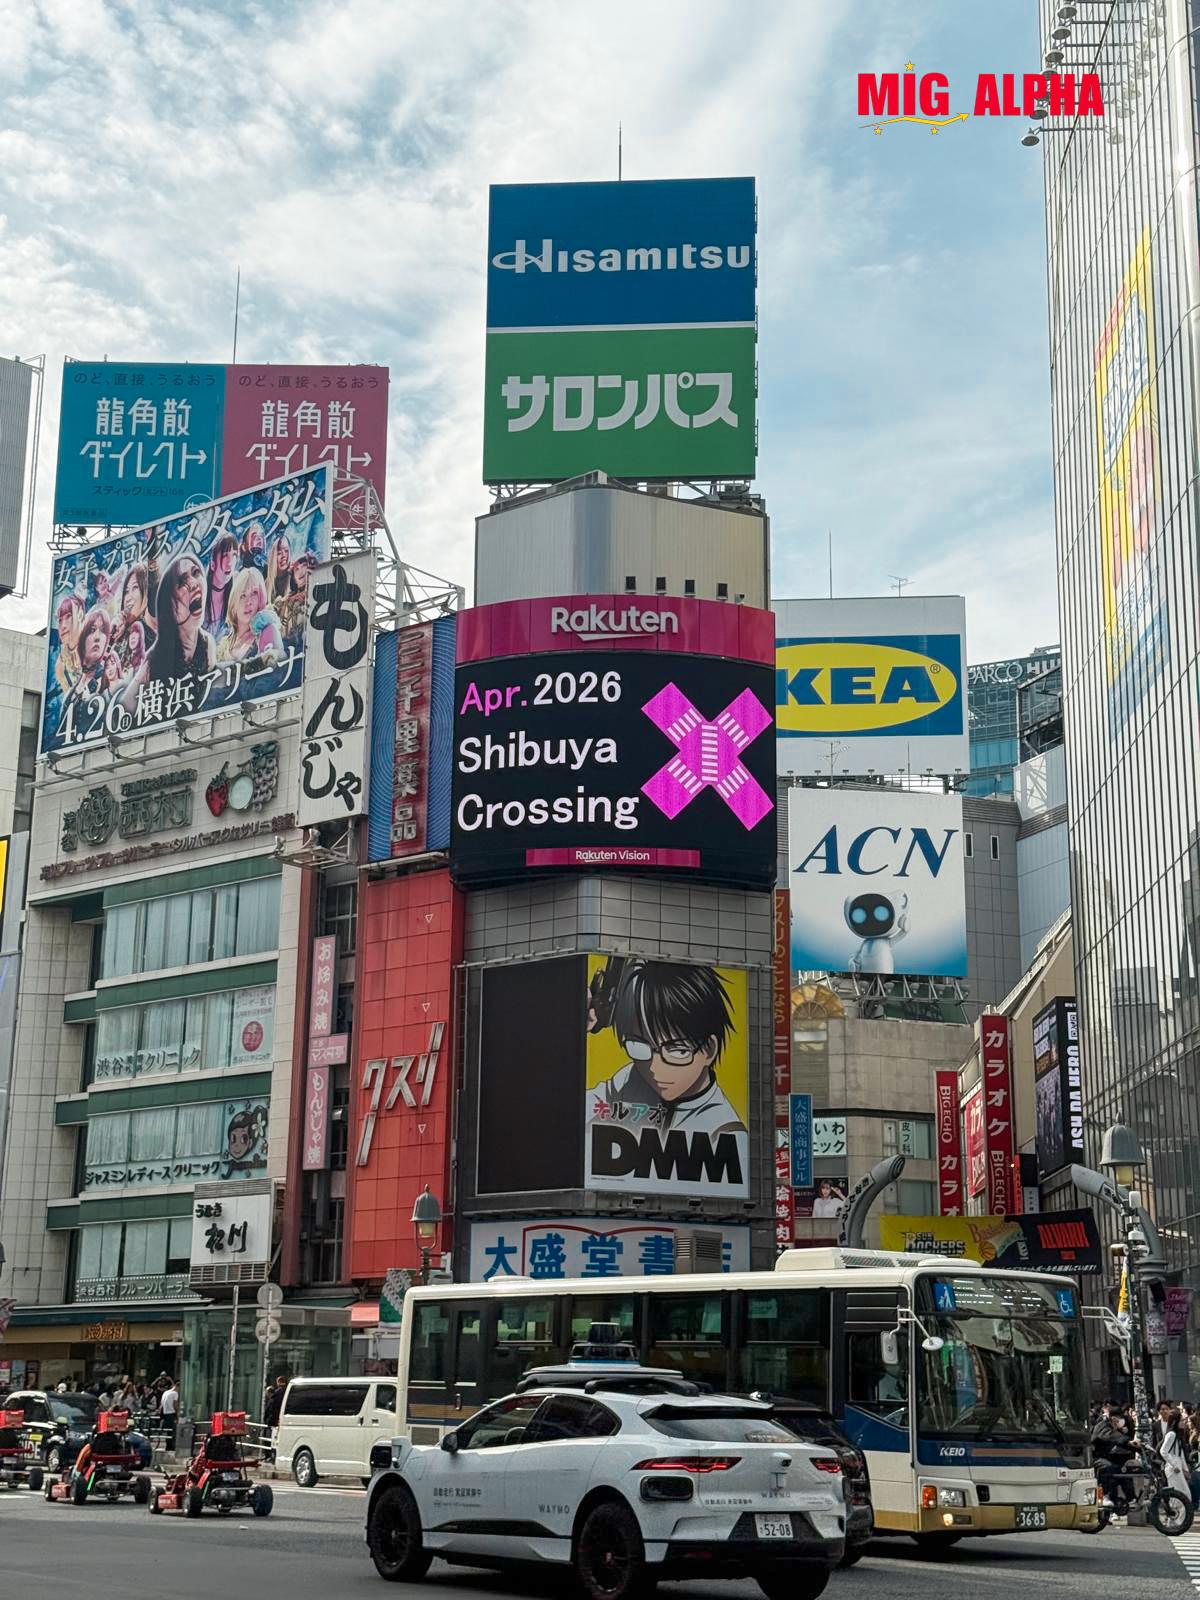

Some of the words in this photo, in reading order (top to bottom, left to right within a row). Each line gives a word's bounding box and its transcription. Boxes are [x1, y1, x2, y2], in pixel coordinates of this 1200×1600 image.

[491, 238, 750, 274] Hisamitsu
[96, 396, 192, 437] 龍角散
[261, 399, 356, 439] 龍角散
[501, 371, 738, 433] サロンパス
[79, 440, 207, 480] ダイレクト
[550, 604, 679, 637] Rakuten
[774, 665, 941, 706] KEA
[1026, 658, 1061, 675] HU
[300, 563, 369, 812] もんじゃ
[459, 681, 528, 717] Apr.
[532, 670, 622, 707] 2026
[457, 730, 618, 774] Shibuya
[456, 785, 640, 832] Crossing
[575, 849, 617, 862] Rakuten
[618, 849, 651, 861] Vision
[791, 823, 959, 879] ACN
[984, 1029, 1009, 1138] カラオケ
[592, 1100, 667, 1124] キルアオ
[591, 1123, 743, 1185] DMM
[483, 1231, 732, 1281] 大盛堂書
[939, 1446, 966, 1457] KEIO
[538, 1503, 571, 1515] WAYMO
[763, 1522, 792, 1537] 52-08
